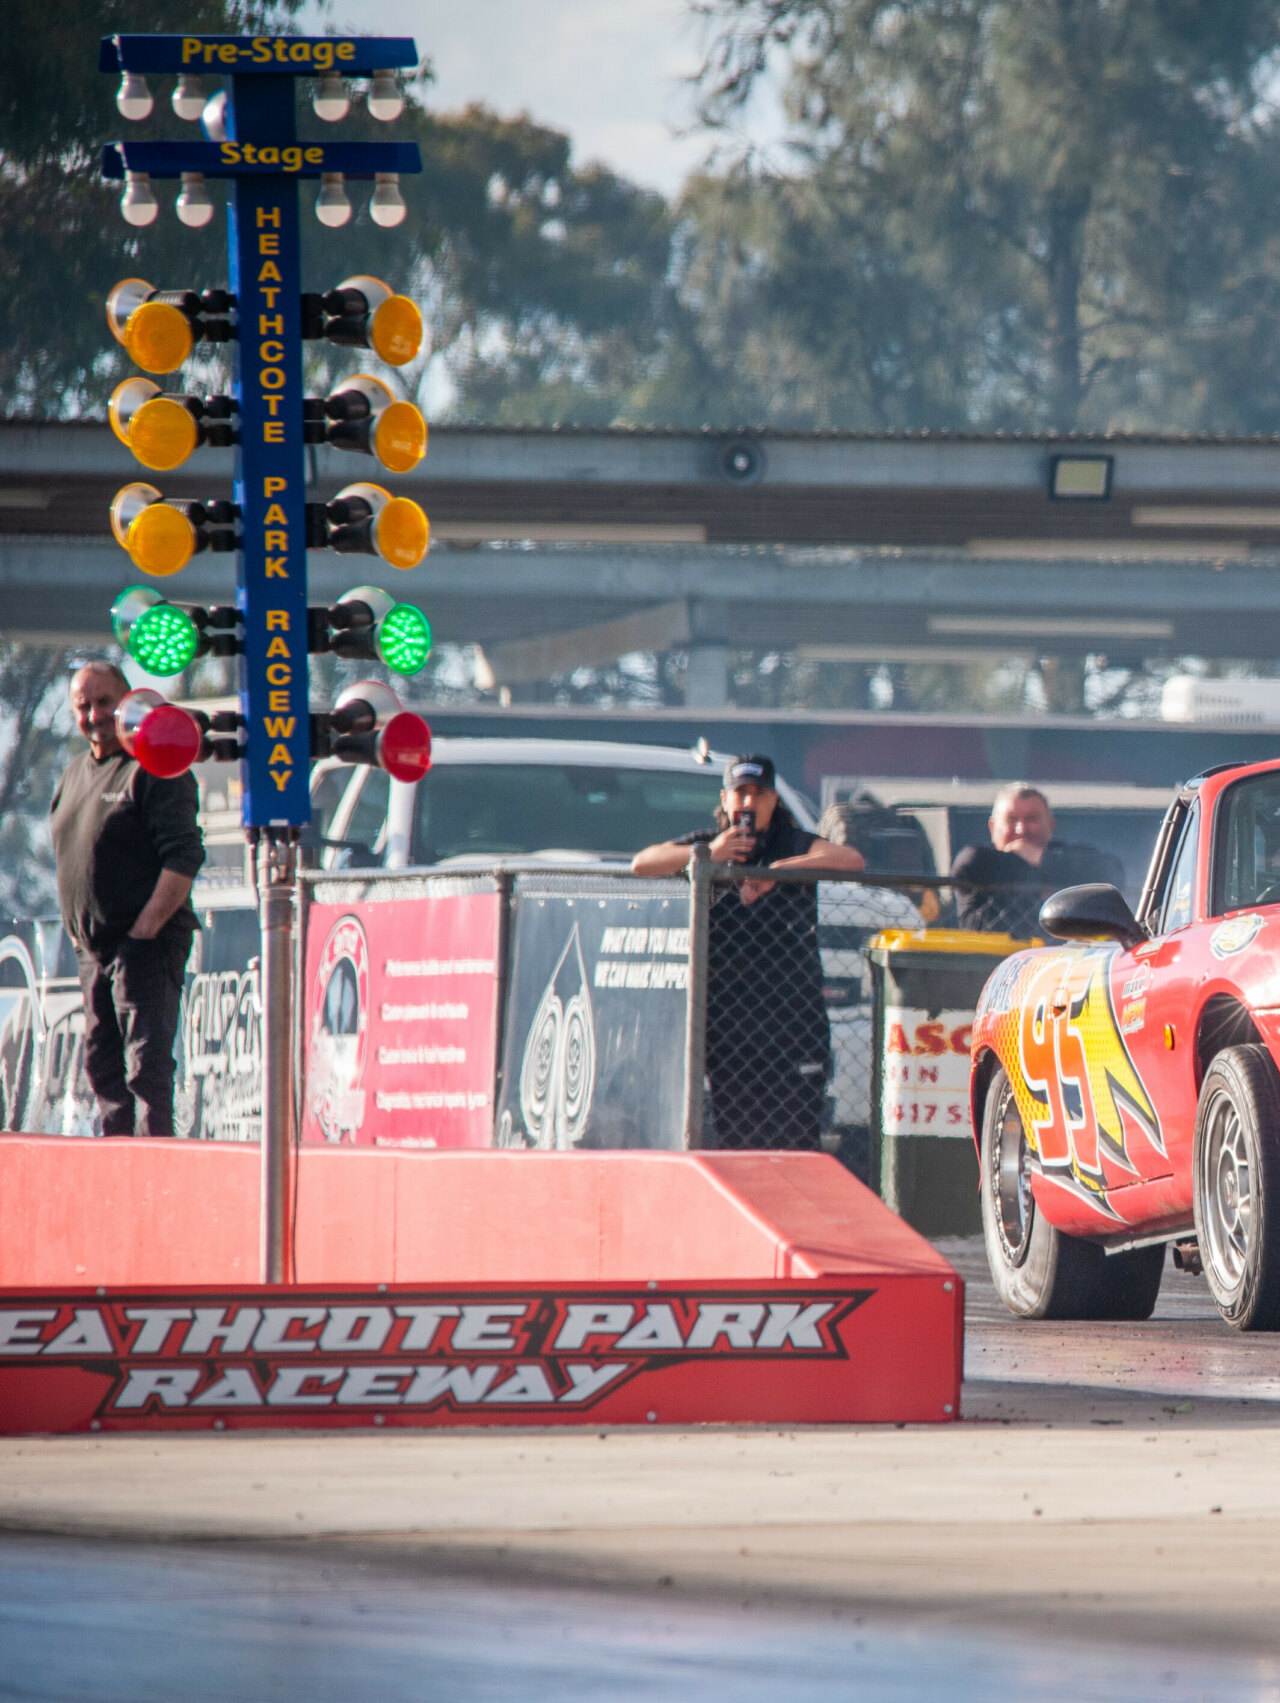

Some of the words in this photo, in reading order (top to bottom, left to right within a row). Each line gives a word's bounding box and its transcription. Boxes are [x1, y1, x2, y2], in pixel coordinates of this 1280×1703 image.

[180, 37, 356, 69] Pre-Stage
[220, 142, 324, 170] Stage
[256, 207, 286, 443] HEATHCOTE
[263, 477, 290, 578] PARK
[263, 610, 297, 792] RACEWAY
[648, 927, 669, 954] YOU
[665, 927, 688, 954] NEE
[608, 960, 628, 988] CAN
[1018, 955, 1104, 1176] 95
[0, 1305, 520, 1354] EATHCOTE
[558, 1303, 832, 1349] PARK
[114, 1363, 630, 1408] RACEWAY
